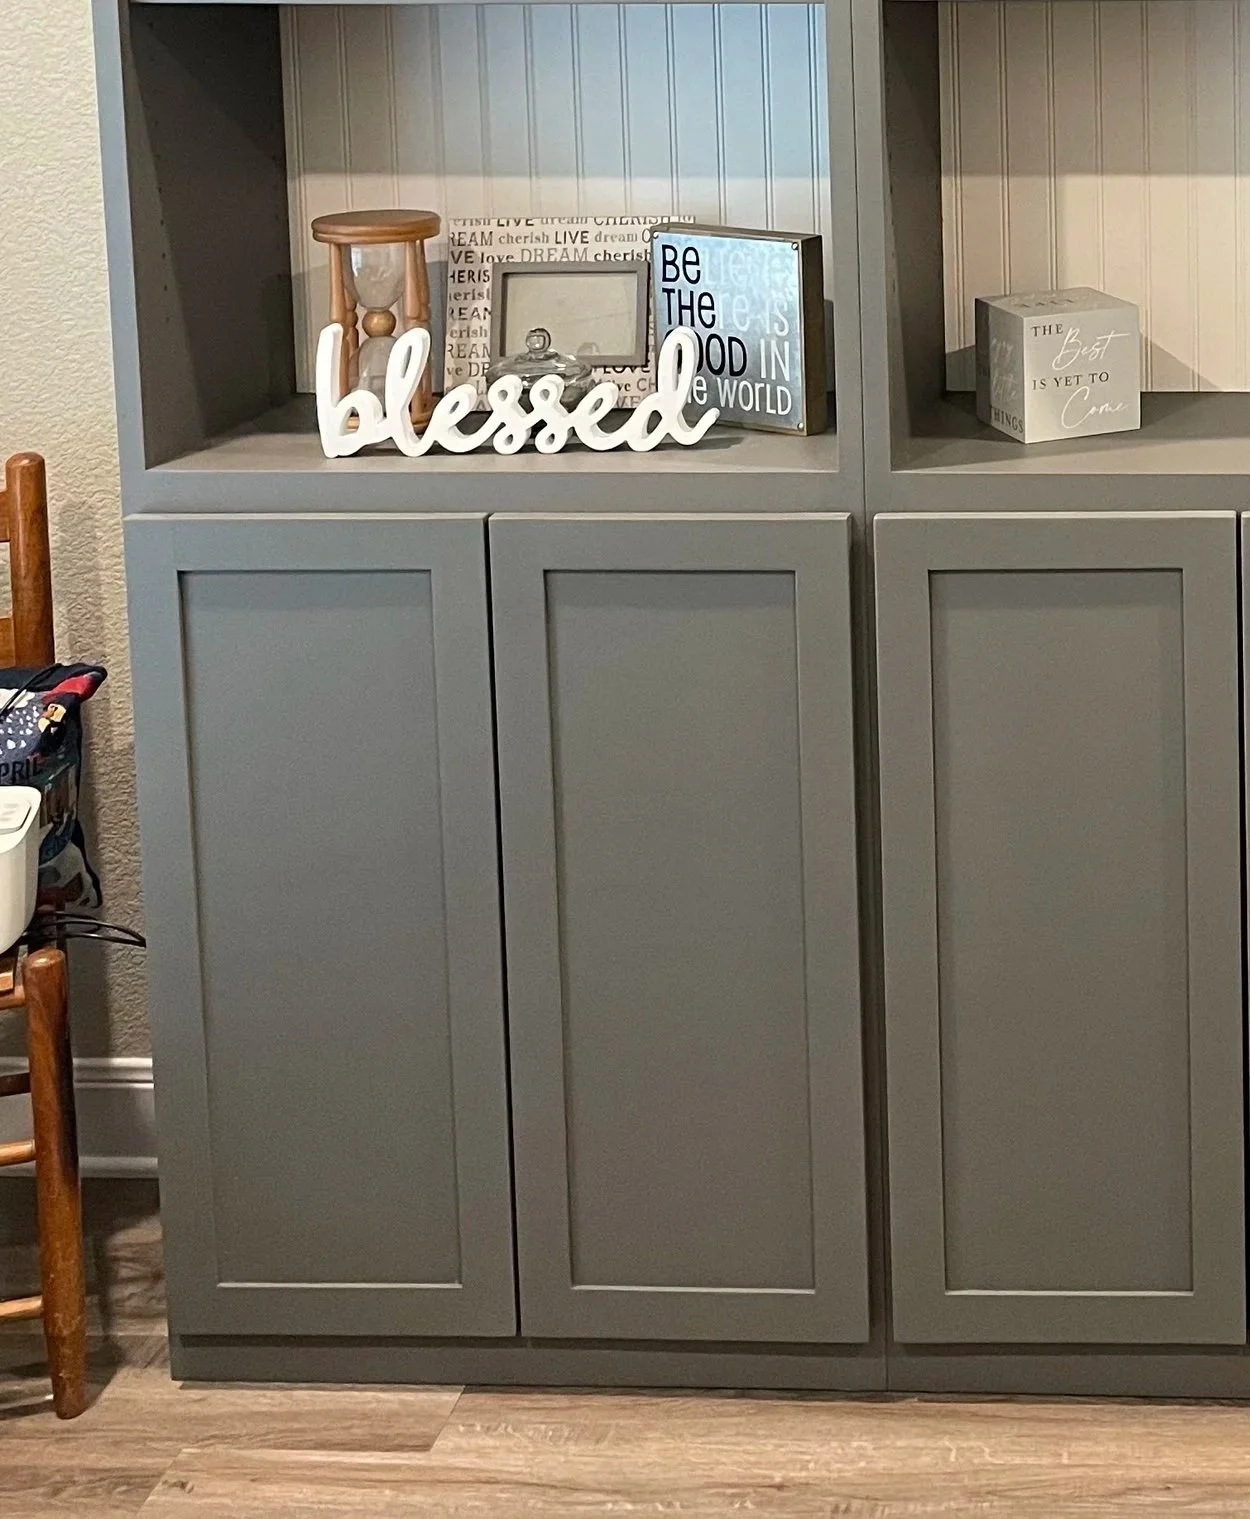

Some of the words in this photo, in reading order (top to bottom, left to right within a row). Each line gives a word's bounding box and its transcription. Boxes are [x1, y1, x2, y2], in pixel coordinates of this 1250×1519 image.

[498, 230, 550, 245] cherish
[555, 230, 590, 245] LIVE
[595, 230, 638, 243] dream
[480, 251, 514, 265] love
[520, 247, 588, 263] DREAM
[1031, 323, 1064, 338] THE
[760, 337, 790, 382] IN
[1052, 327, 1130, 371] Best
[315, 322, 720, 459] blessed
[1032, 377, 1047, 391] IS
[1053, 373, 1083, 389] YET
[1088, 371, 1110, 384] TO
[1060, 385, 1128, 430] Come
